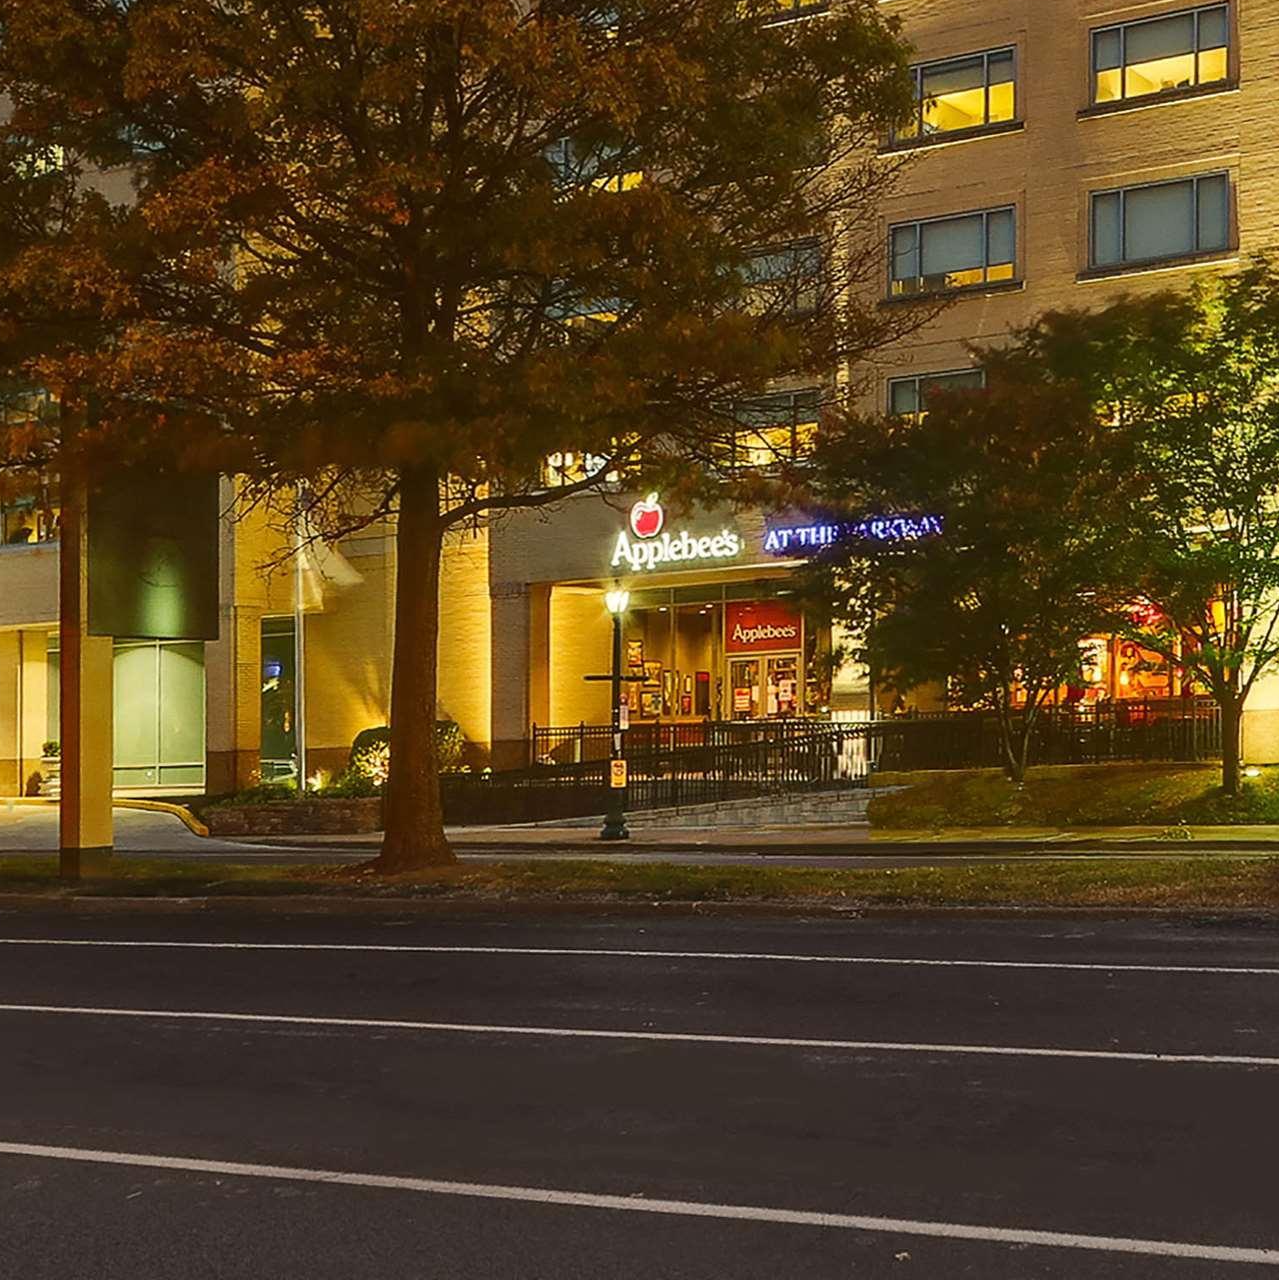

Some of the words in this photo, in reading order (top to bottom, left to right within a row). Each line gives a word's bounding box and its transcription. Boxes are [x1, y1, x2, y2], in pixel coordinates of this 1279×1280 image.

[610, 528, 741, 571] Applebee's
[764, 529, 793, 551] AT
[844, 515, 944, 541] ARKWAY
[732, 623, 798, 643] Applebee's
